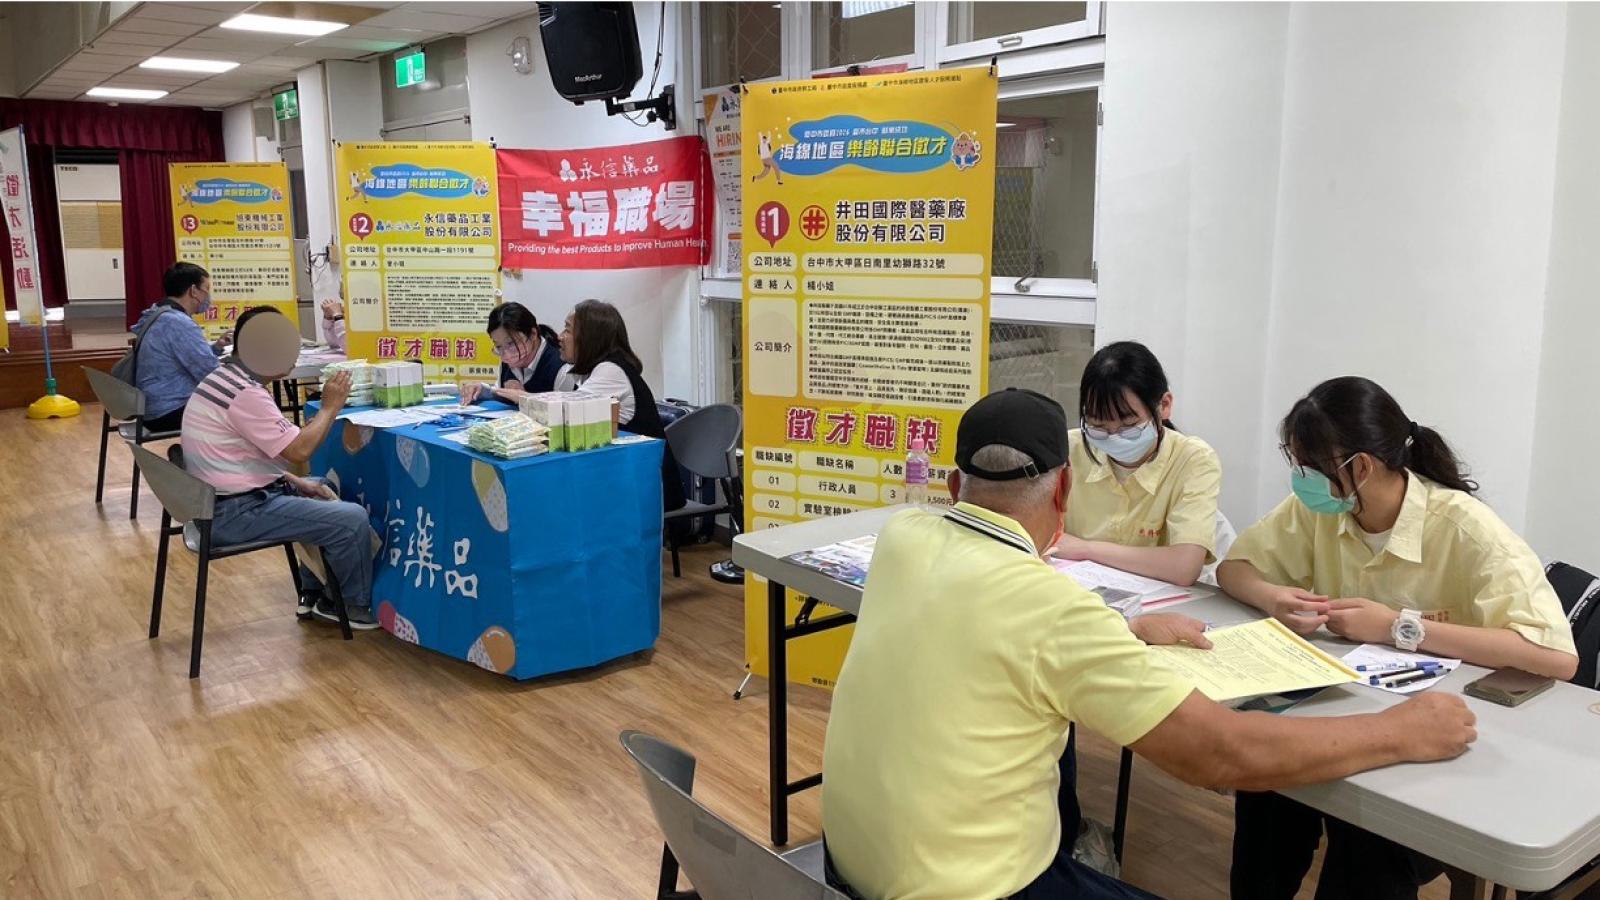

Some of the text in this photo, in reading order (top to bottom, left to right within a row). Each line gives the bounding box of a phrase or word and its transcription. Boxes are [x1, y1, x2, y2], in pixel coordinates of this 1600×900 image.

[579, 155, 659, 181] 永信藥品
[520, 181, 696, 238] 幸福職場
[835, 200, 966, 219] 井田國際醫藥廠
[358, 216, 370, 233] 2
[424, 213, 492, 224] 永信藥品工業
[767, 207, 780, 237] 1
[424, 226, 493, 237] 股份有限公司
[835, 223, 946, 243] 股份有限公司
[507, 242, 546, 255] Providing
[547, 245, 560, 255] the
[561, 244, 579, 254] best
[579, 243, 613, 254] Products
[613, 243, 622, 252] to
[654, 239, 685, 249] Human
[753, 256, 792, 267] 公司地址
[377, 337, 475, 359] 徵才職缺
[753, 341, 793, 353] 公司簡介
[787, 407, 938, 453] 徵才職缺
[755, 450, 793, 464] 職缺編號
[816, 456, 855, 470] 職缺名稱
[882, 461, 903, 475] 人數
[768, 476, 780, 485] 01
[818, 483, 857, 496] 行政人員
[889, 489, 897, 499] 3
[768, 499, 780, 509] 02
[803, 503, 859, 517] 實驗室檢驗
